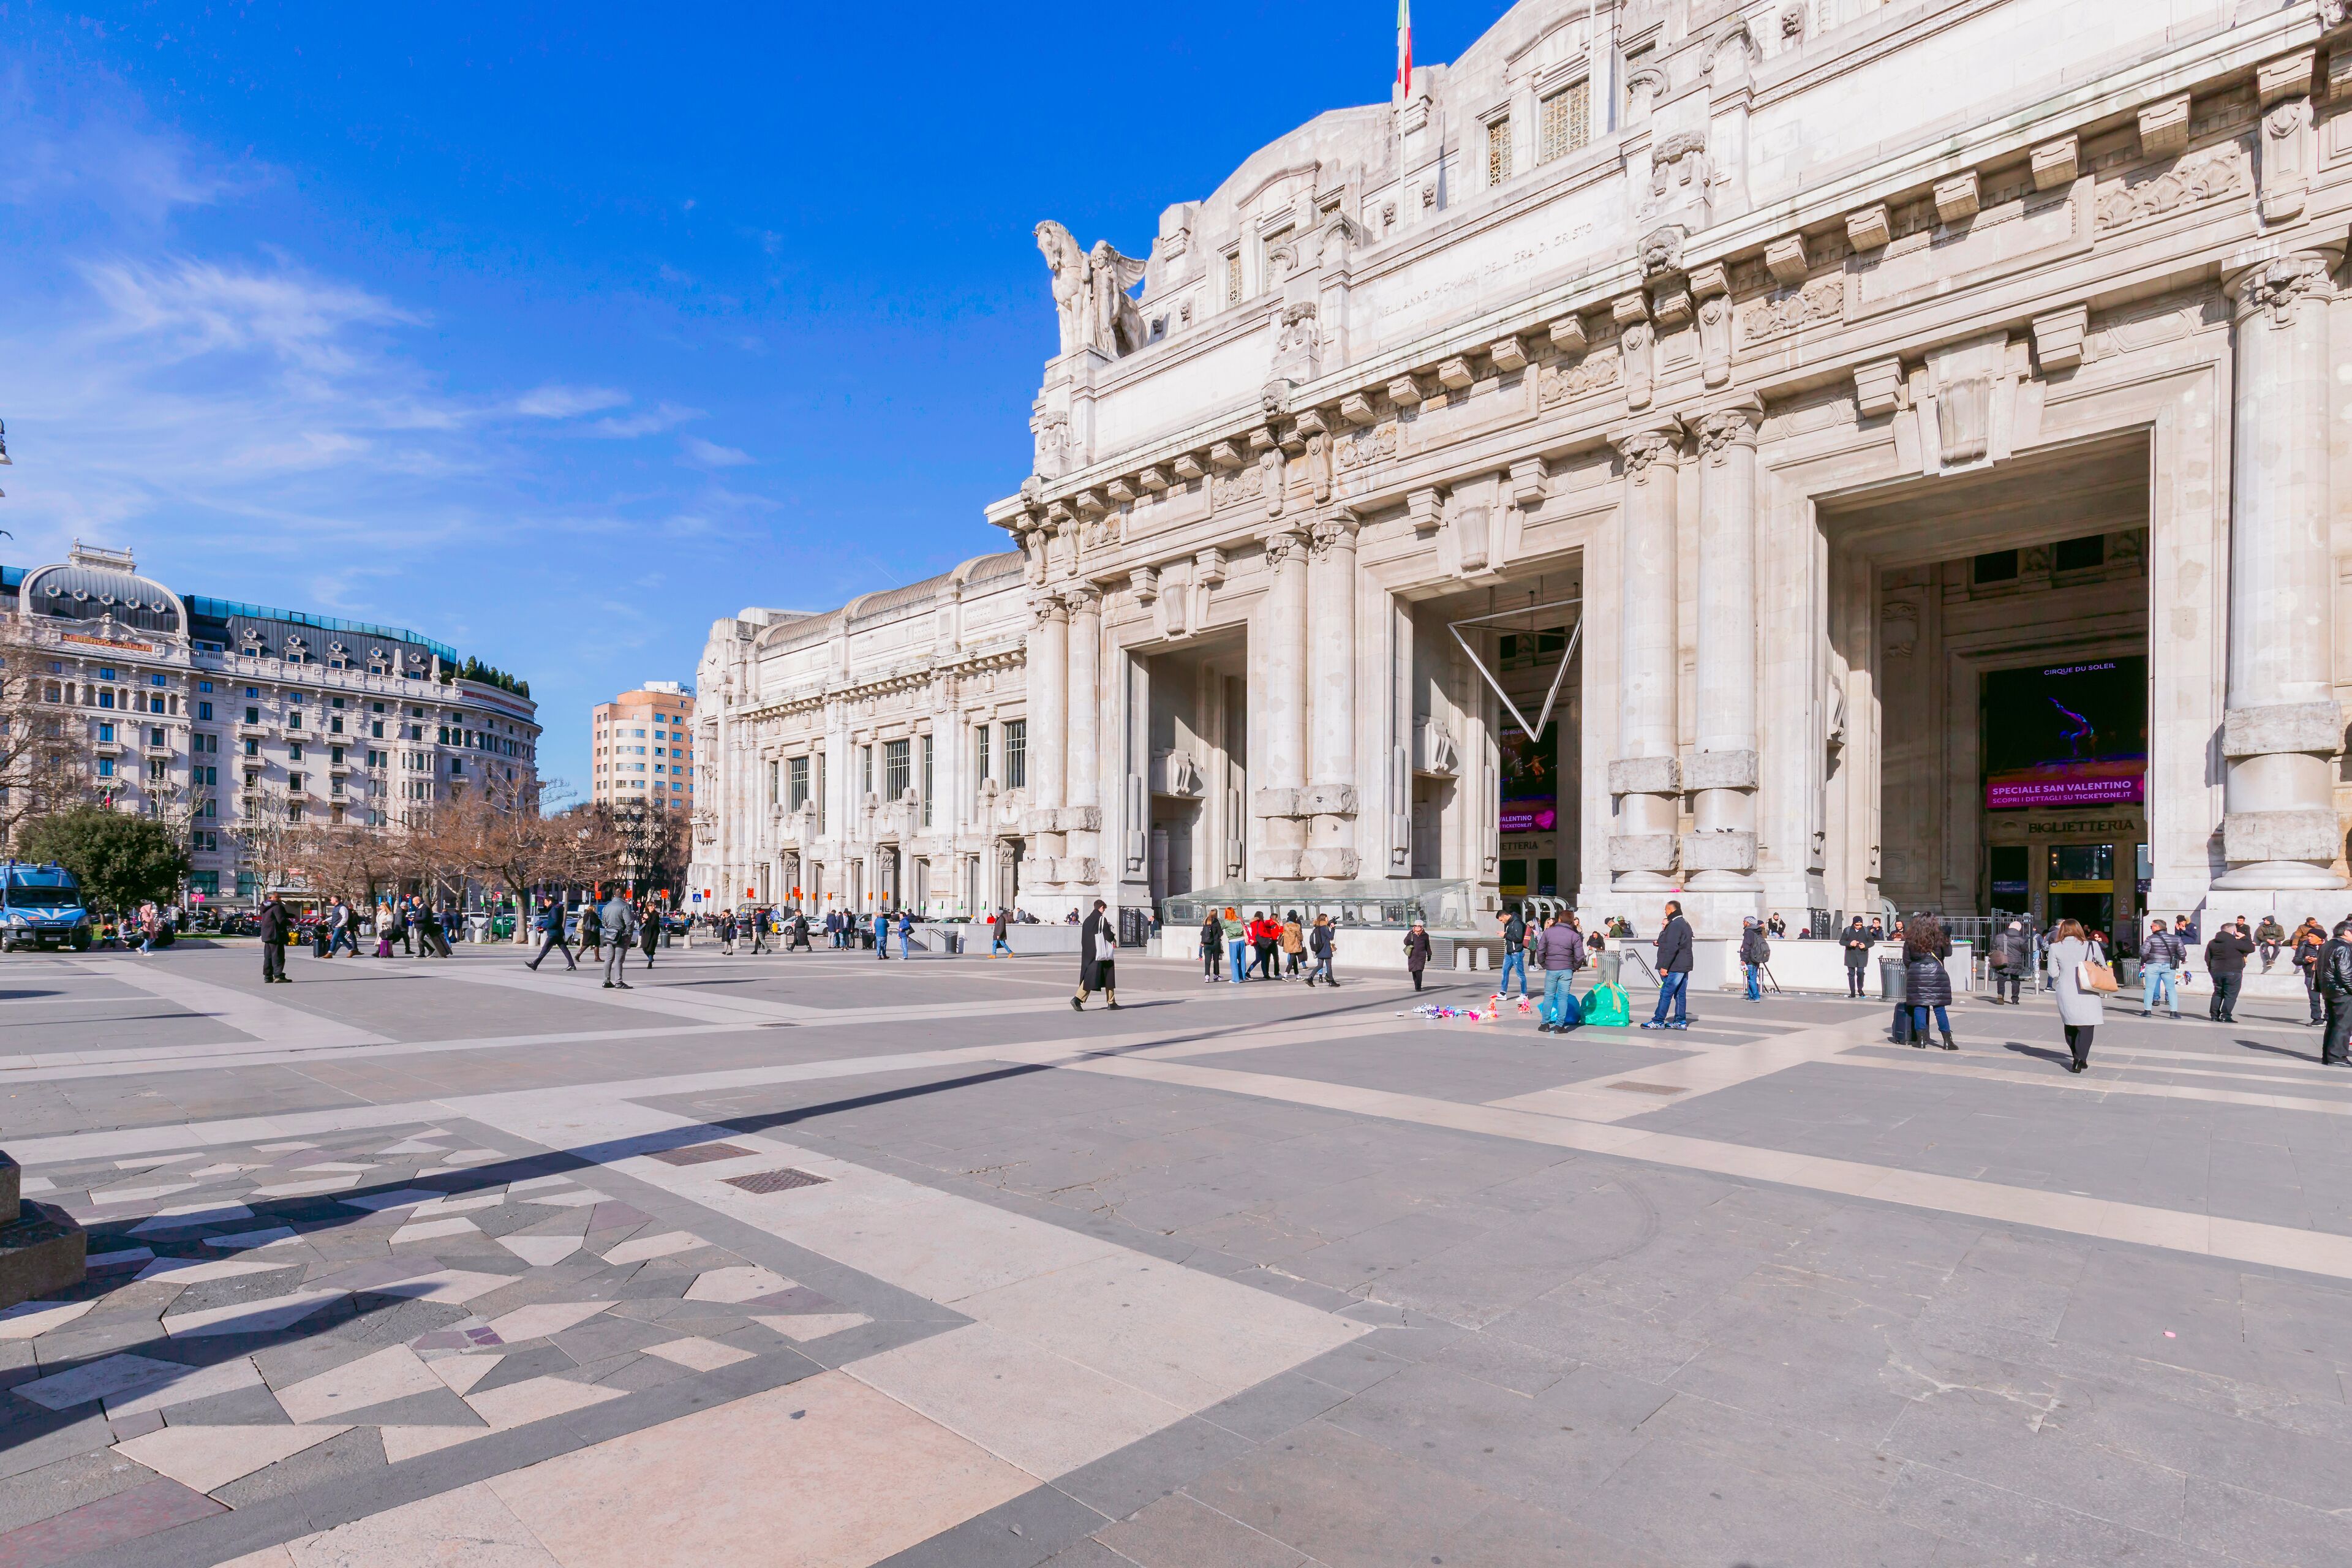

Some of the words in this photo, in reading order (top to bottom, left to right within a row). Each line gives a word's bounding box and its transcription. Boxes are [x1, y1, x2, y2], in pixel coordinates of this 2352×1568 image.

[62, 635, 111, 646] ALBERGO
[116, 641, 152, 651] GALLIA
[2044, 667, 2073, 676] CIRQUE
[1992, 786, 2040, 795] SPECIALE
[2043, 784, 2064, 793] SAN
[2067, 781, 2132, 791] VALENTINO
[2029, 820, 2135, 833] BIGLIETTERIA
